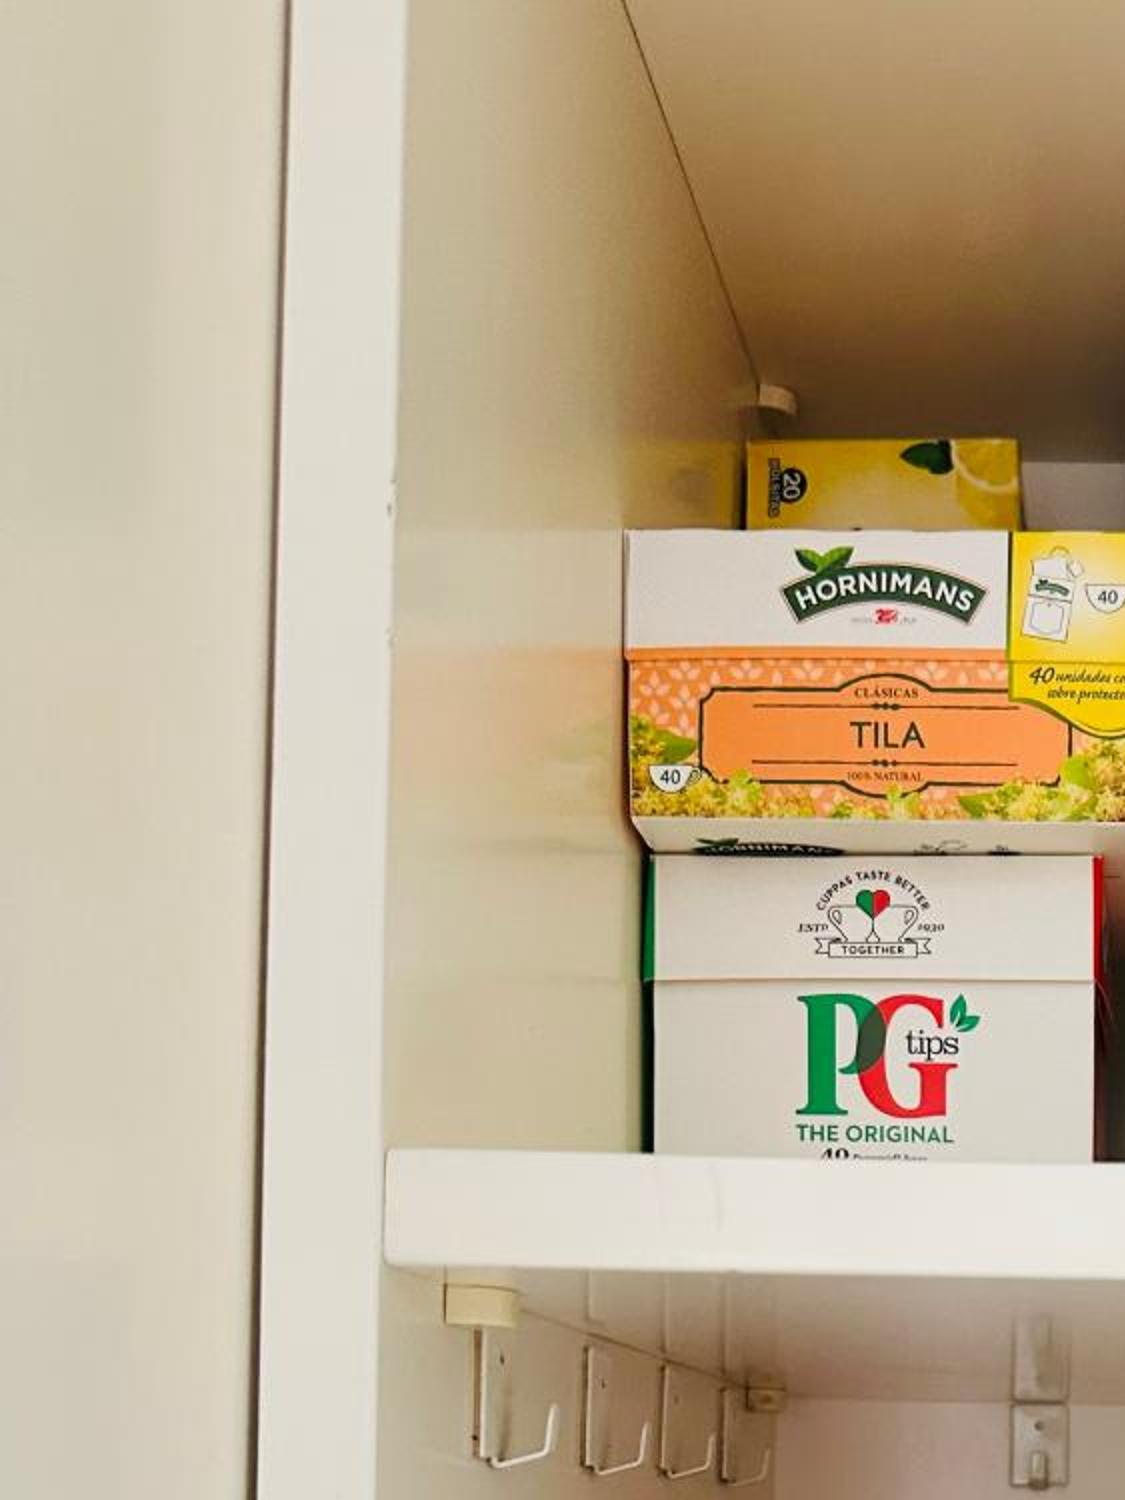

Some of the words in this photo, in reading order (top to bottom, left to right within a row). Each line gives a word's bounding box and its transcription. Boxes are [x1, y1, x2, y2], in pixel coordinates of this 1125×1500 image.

[783, 472, 801, 499] 20
[795, 571, 974, 612] HORNIMANS
[1097, 590, 1119, 605] 40
[1029, 667, 1055, 685] 40
[854, 687, 919, 698] CLÁSICAS
[850, 721, 925, 748] TILA
[660, 769, 681, 784] 40
[856, 870, 890, 882] TASTE
[894, 875, 931, 910] BETTER
[841, 945, 905, 955] TOGETHER
[796, 993, 958, 1118] PG
[906, 1030, 959, 1062] tips
[796, 1124, 839, 1142] THE
[846, 1124, 955, 1143] ORIGINAL
